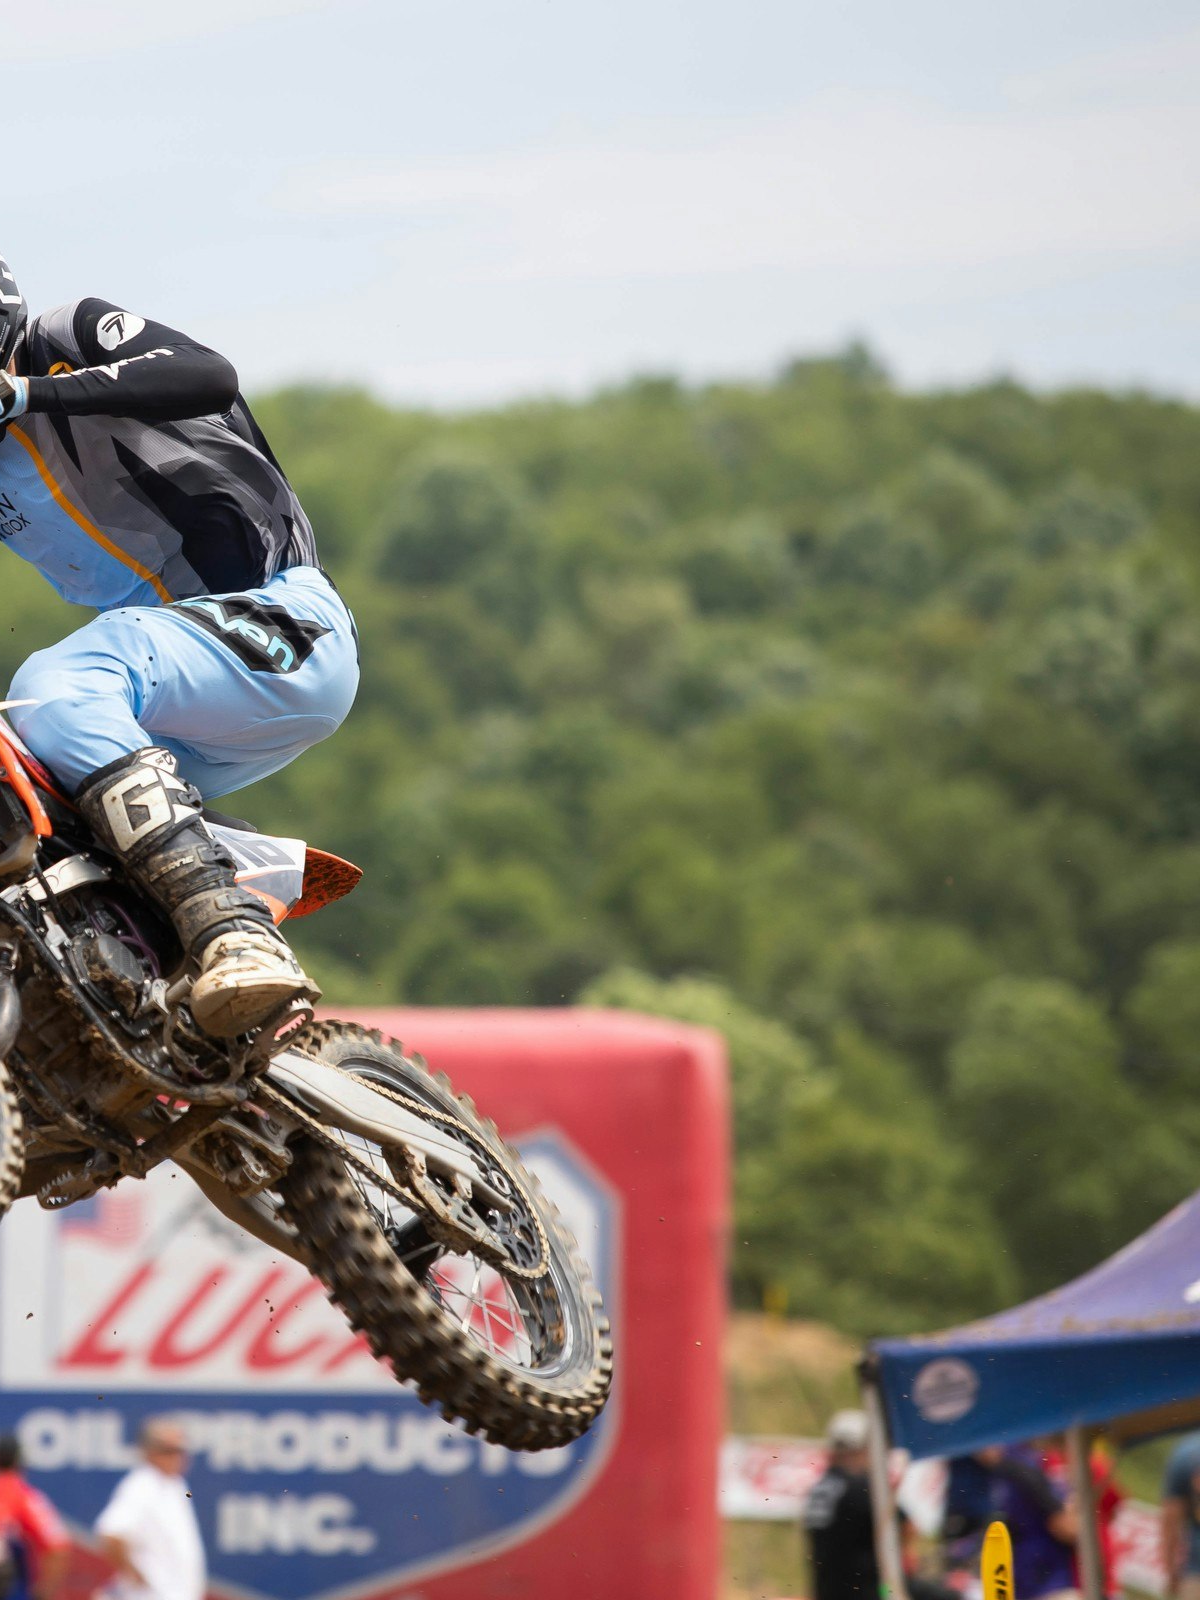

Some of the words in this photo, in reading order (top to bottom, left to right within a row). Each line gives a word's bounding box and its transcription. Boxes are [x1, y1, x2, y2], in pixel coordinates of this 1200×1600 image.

[213, 828, 296, 870] 16
[56, 1257, 522, 1372] LUC
[14, 1409, 140, 1472] OIL
[216, 1495, 377, 1555] INC.
